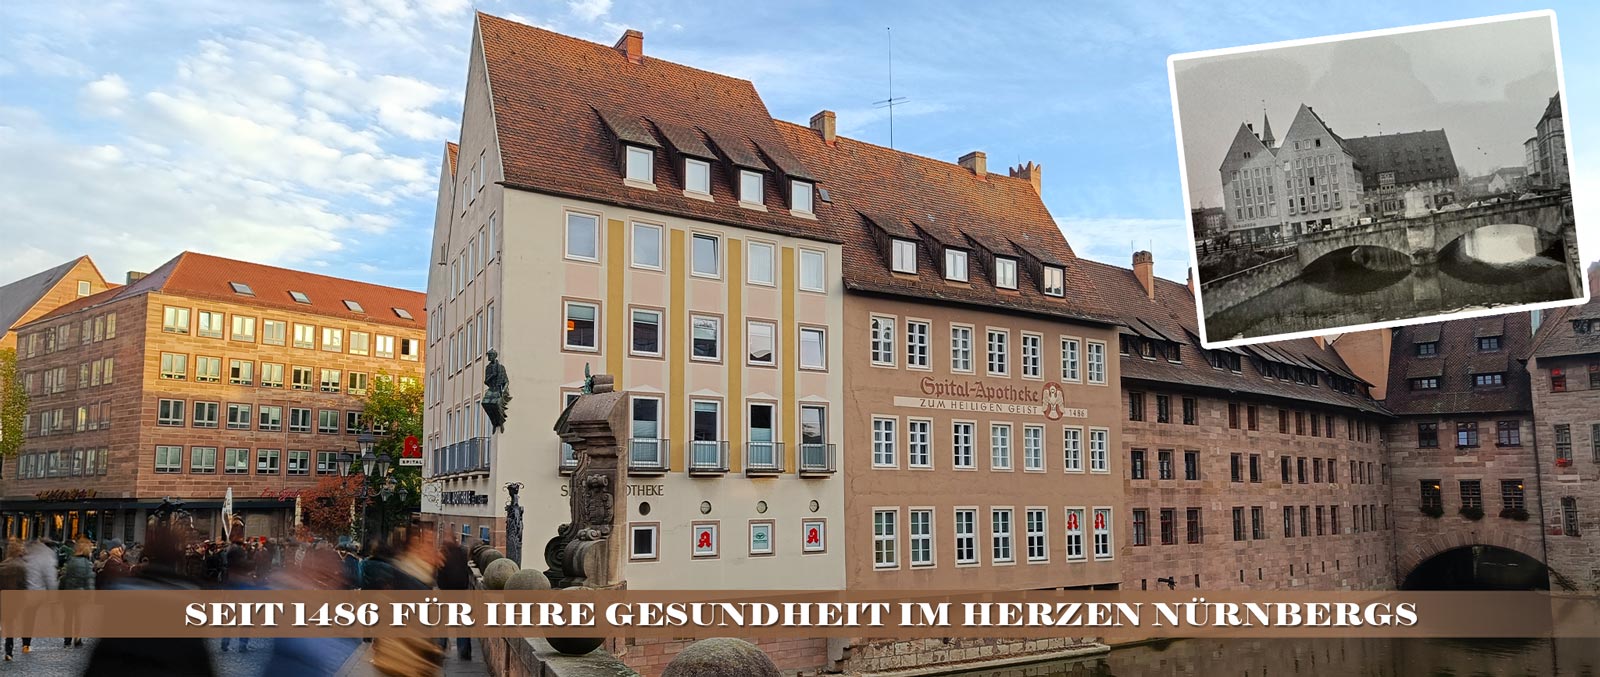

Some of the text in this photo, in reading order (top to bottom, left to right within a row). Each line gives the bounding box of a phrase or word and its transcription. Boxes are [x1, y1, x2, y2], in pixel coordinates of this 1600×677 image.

[920, 376, 1039, 402] Spital-Apotheke
[919, 398, 1086, 417] ZUM HEILIGEN GEIST 1486
